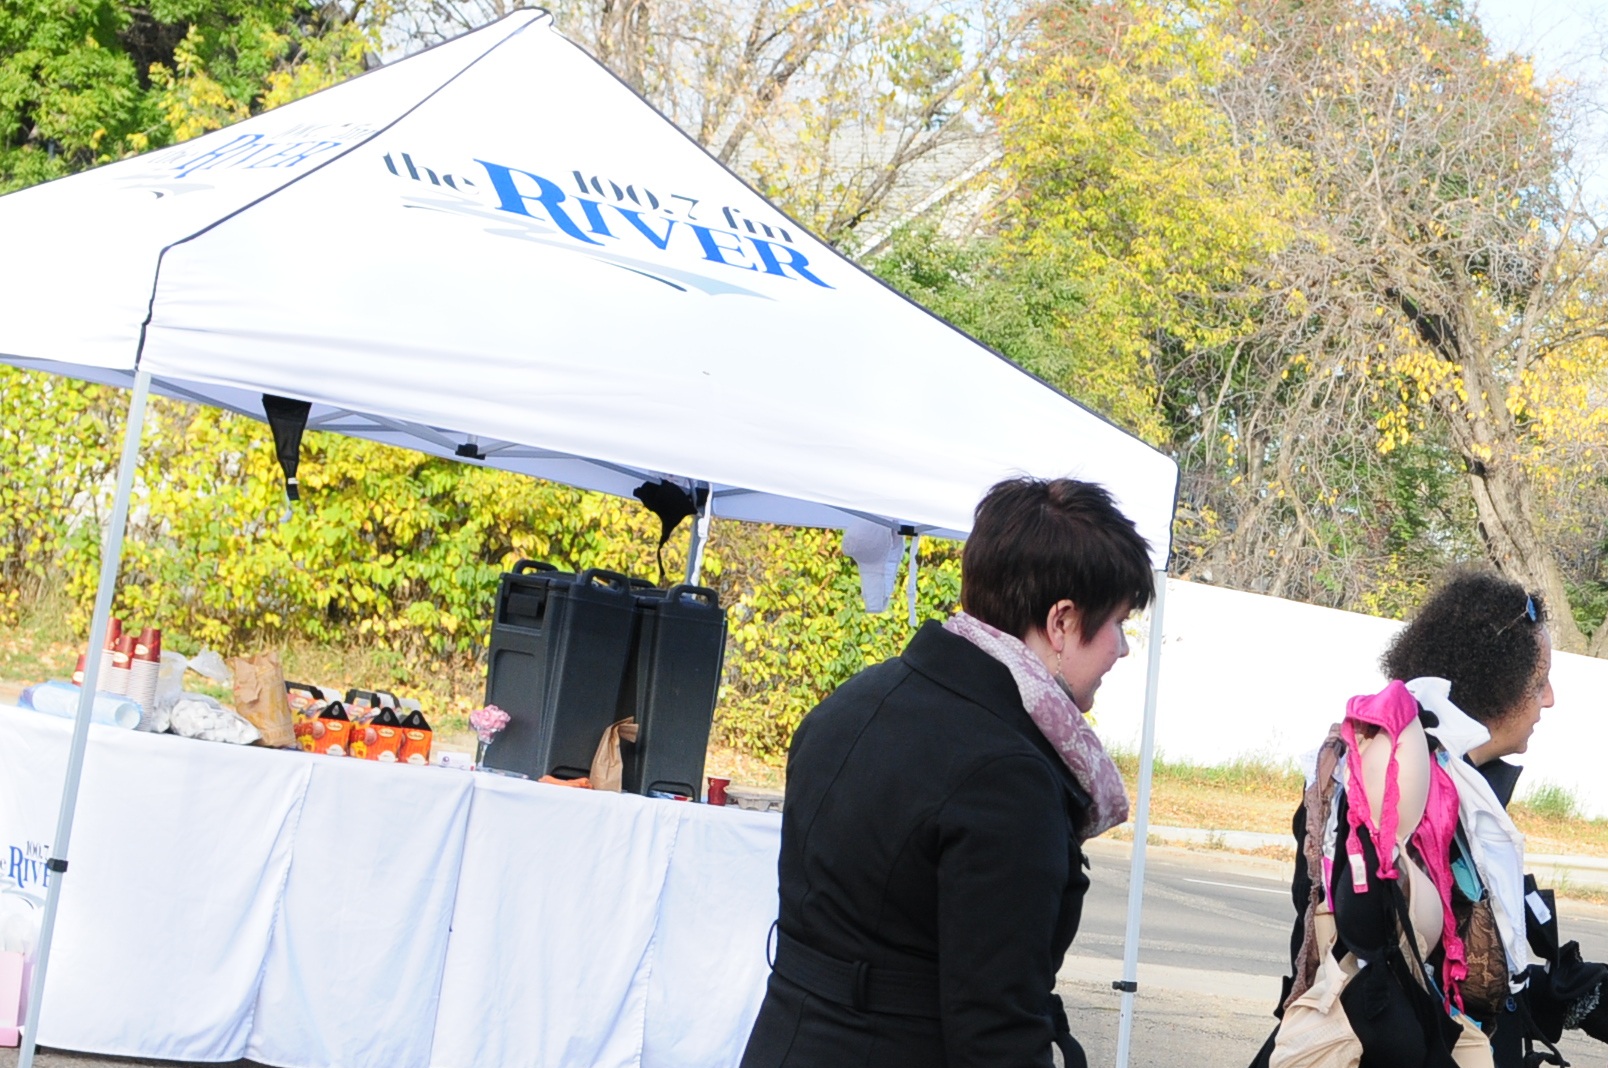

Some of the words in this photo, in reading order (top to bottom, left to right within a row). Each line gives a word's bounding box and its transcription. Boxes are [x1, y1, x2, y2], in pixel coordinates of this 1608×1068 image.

[172, 134, 343, 179] RIVER
[382, 151, 481, 196] the
[472, 157, 838, 290] RIVER
[571, 169, 700, 220] 100.7
[721, 204, 794, 244] fm
